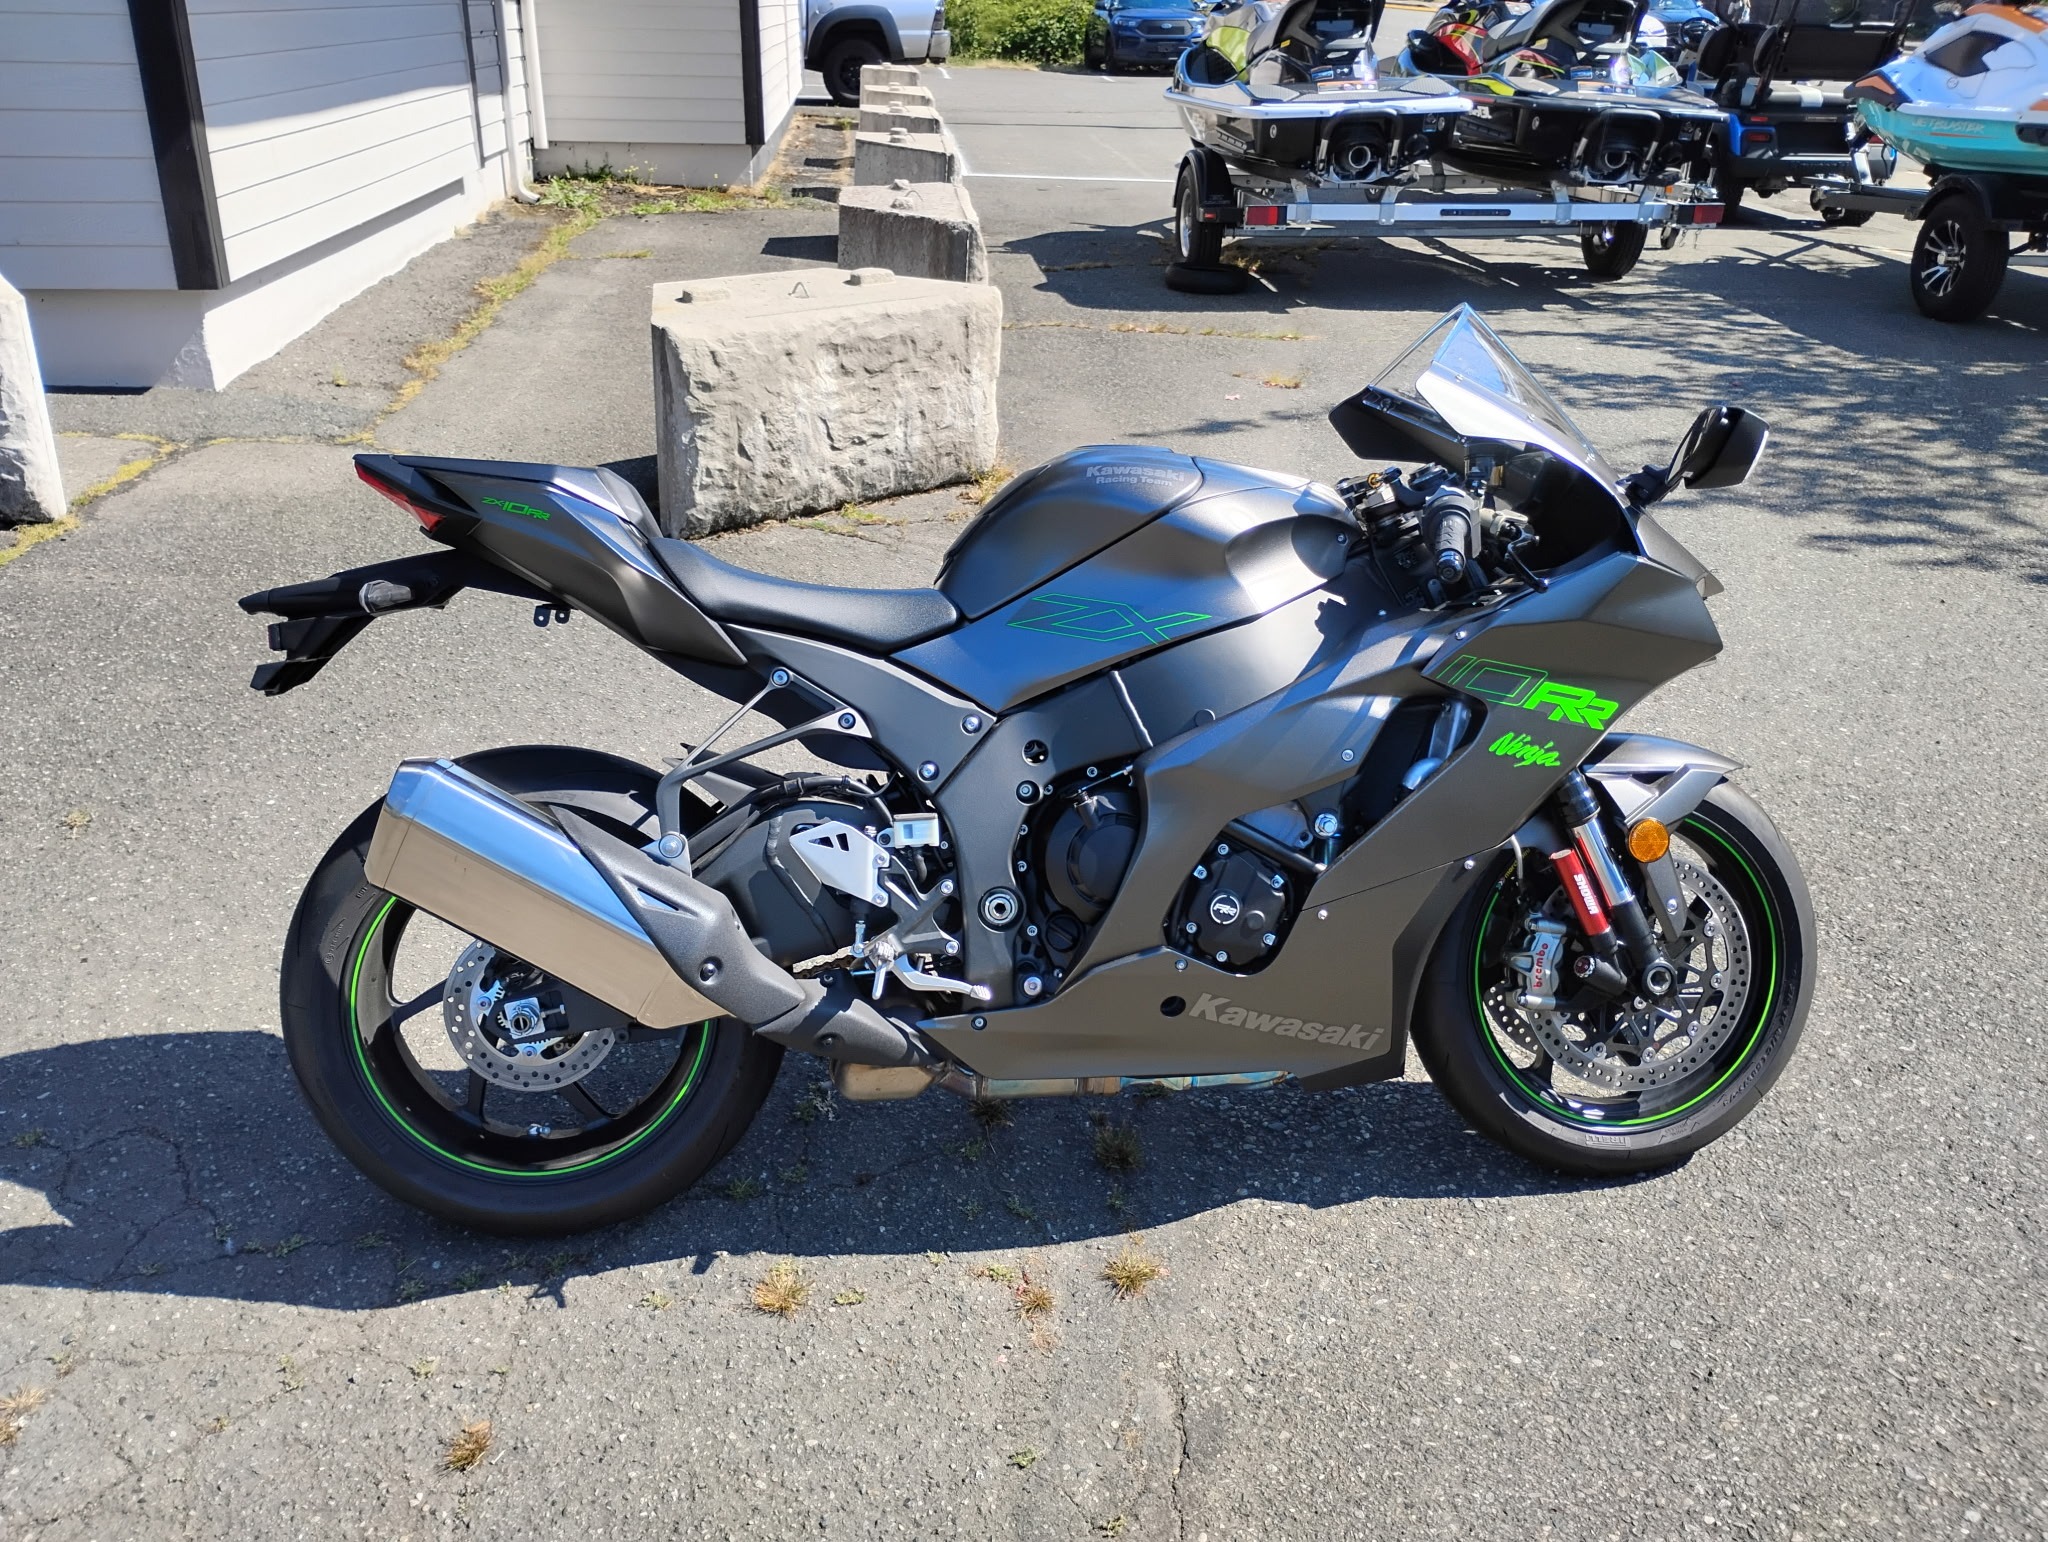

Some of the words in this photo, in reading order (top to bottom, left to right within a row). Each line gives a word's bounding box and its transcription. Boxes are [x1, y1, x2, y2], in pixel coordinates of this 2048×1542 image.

[1086, 465, 1185, 482] Kawasaki
[1096, 475, 1138, 484] Racing
[1140, 476, 1173, 487] Team
[1007, 593, 1212, 646] ZX
[1488, 731, 1561, 768] Ninja
[1573, 873, 1600, 915] SHOWA
[1533, 943, 1549, 988] brembo
[1189, 992, 1385, 1051] Kawasaki
